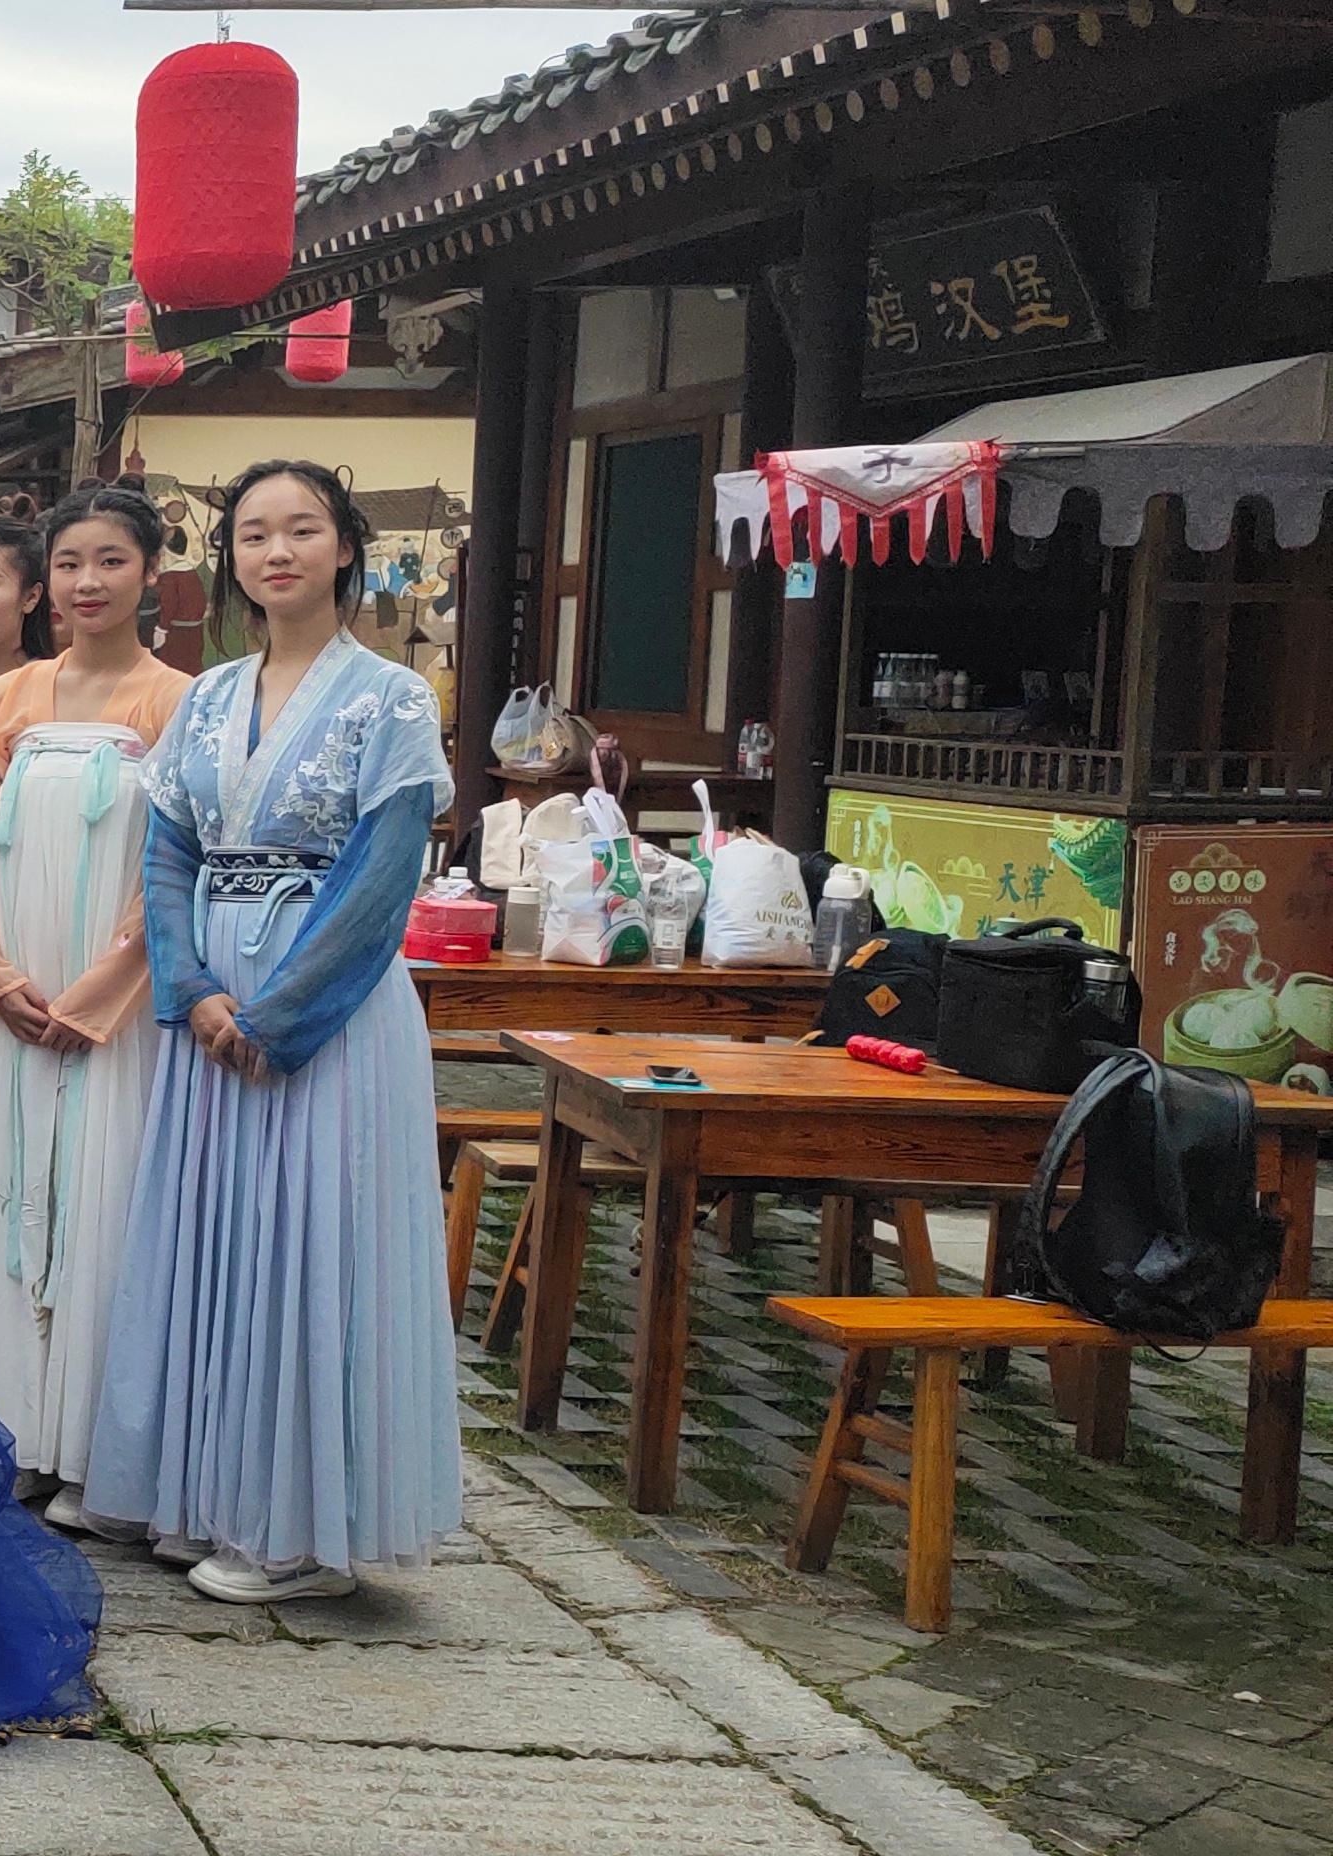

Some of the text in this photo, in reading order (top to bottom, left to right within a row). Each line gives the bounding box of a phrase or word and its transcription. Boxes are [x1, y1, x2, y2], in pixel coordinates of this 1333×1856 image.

[996, 862, 1050, 912] 天津
[1172, 895, 1193, 905] LAO
[1195, 895, 1231, 905] SHANG
